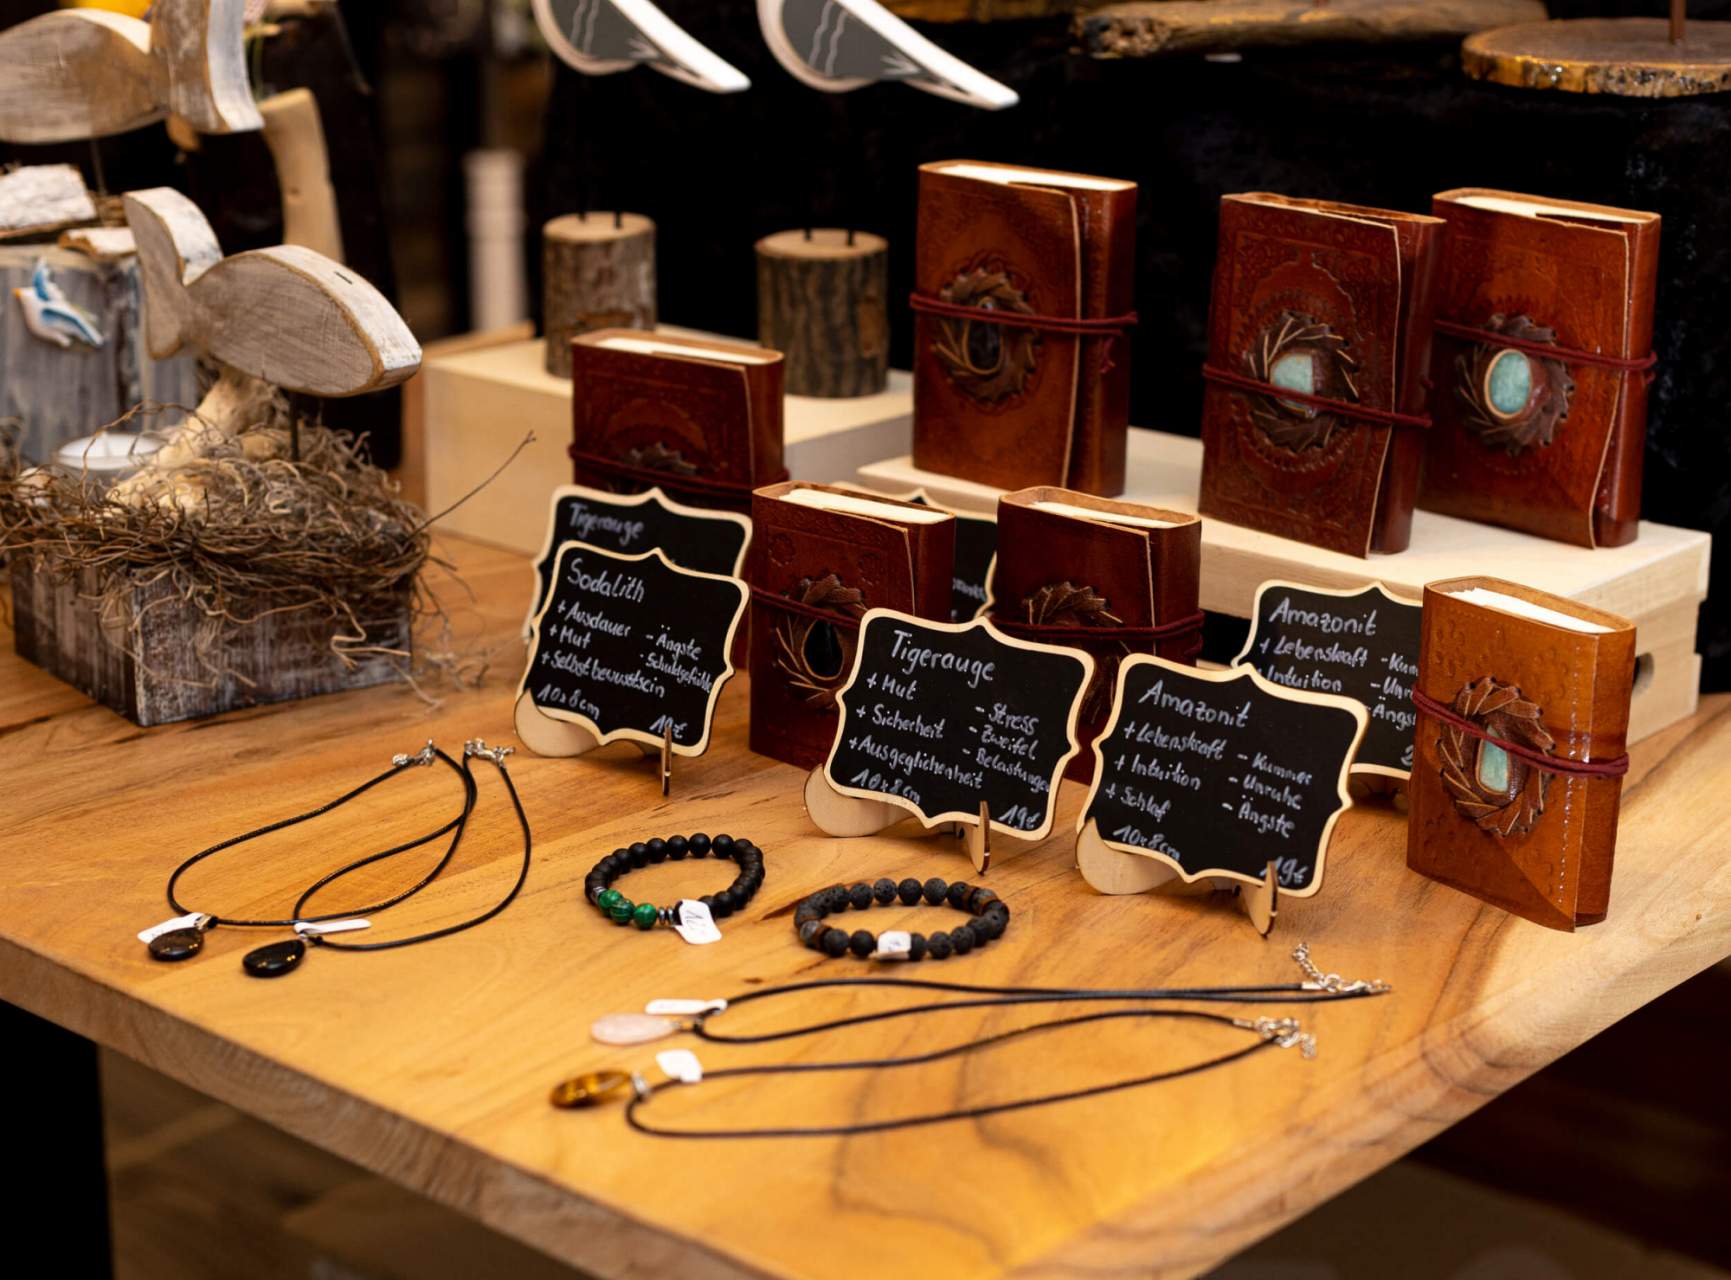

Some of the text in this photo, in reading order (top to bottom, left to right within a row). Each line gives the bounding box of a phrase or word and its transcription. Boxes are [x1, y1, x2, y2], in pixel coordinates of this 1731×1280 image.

[567, 557, 645, 603] Sodalith
[564, 601, 631, 637] Ausdauer
[1268, 596, 1377, 636] Amazonit
[560, 625, 591, 649] Mut
[655, 624, 702, 661] Ängste
[891, 629, 995, 689] Tigerauge
[1266, 663, 1343, 692] Intuition
[882, 674, 917, 700] Mut
[1138, 679, 1251, 728] Amazonit
[1383, 675, 1413, 700] Unr
[872, 703, 945, 739] Sicherheit
[988, 703, 1039, 735] Stress
[981, 724, 1038, 760] Zweifel
[1136, 721, 1228, 760] Lebenskraft
[857, 734, 983, 789] Ausgeglichenheit
[1130, 752, 1201, 791] Intuition
[1252, 751, 1312, 785] Kummer
[1120, 785, 1172, 823] Schlaf
[1242, 773, 1303, 810] Unruhe
[998, 804, 1040, 829] 19€
[1238, 793, 1295, 839] Ängste
